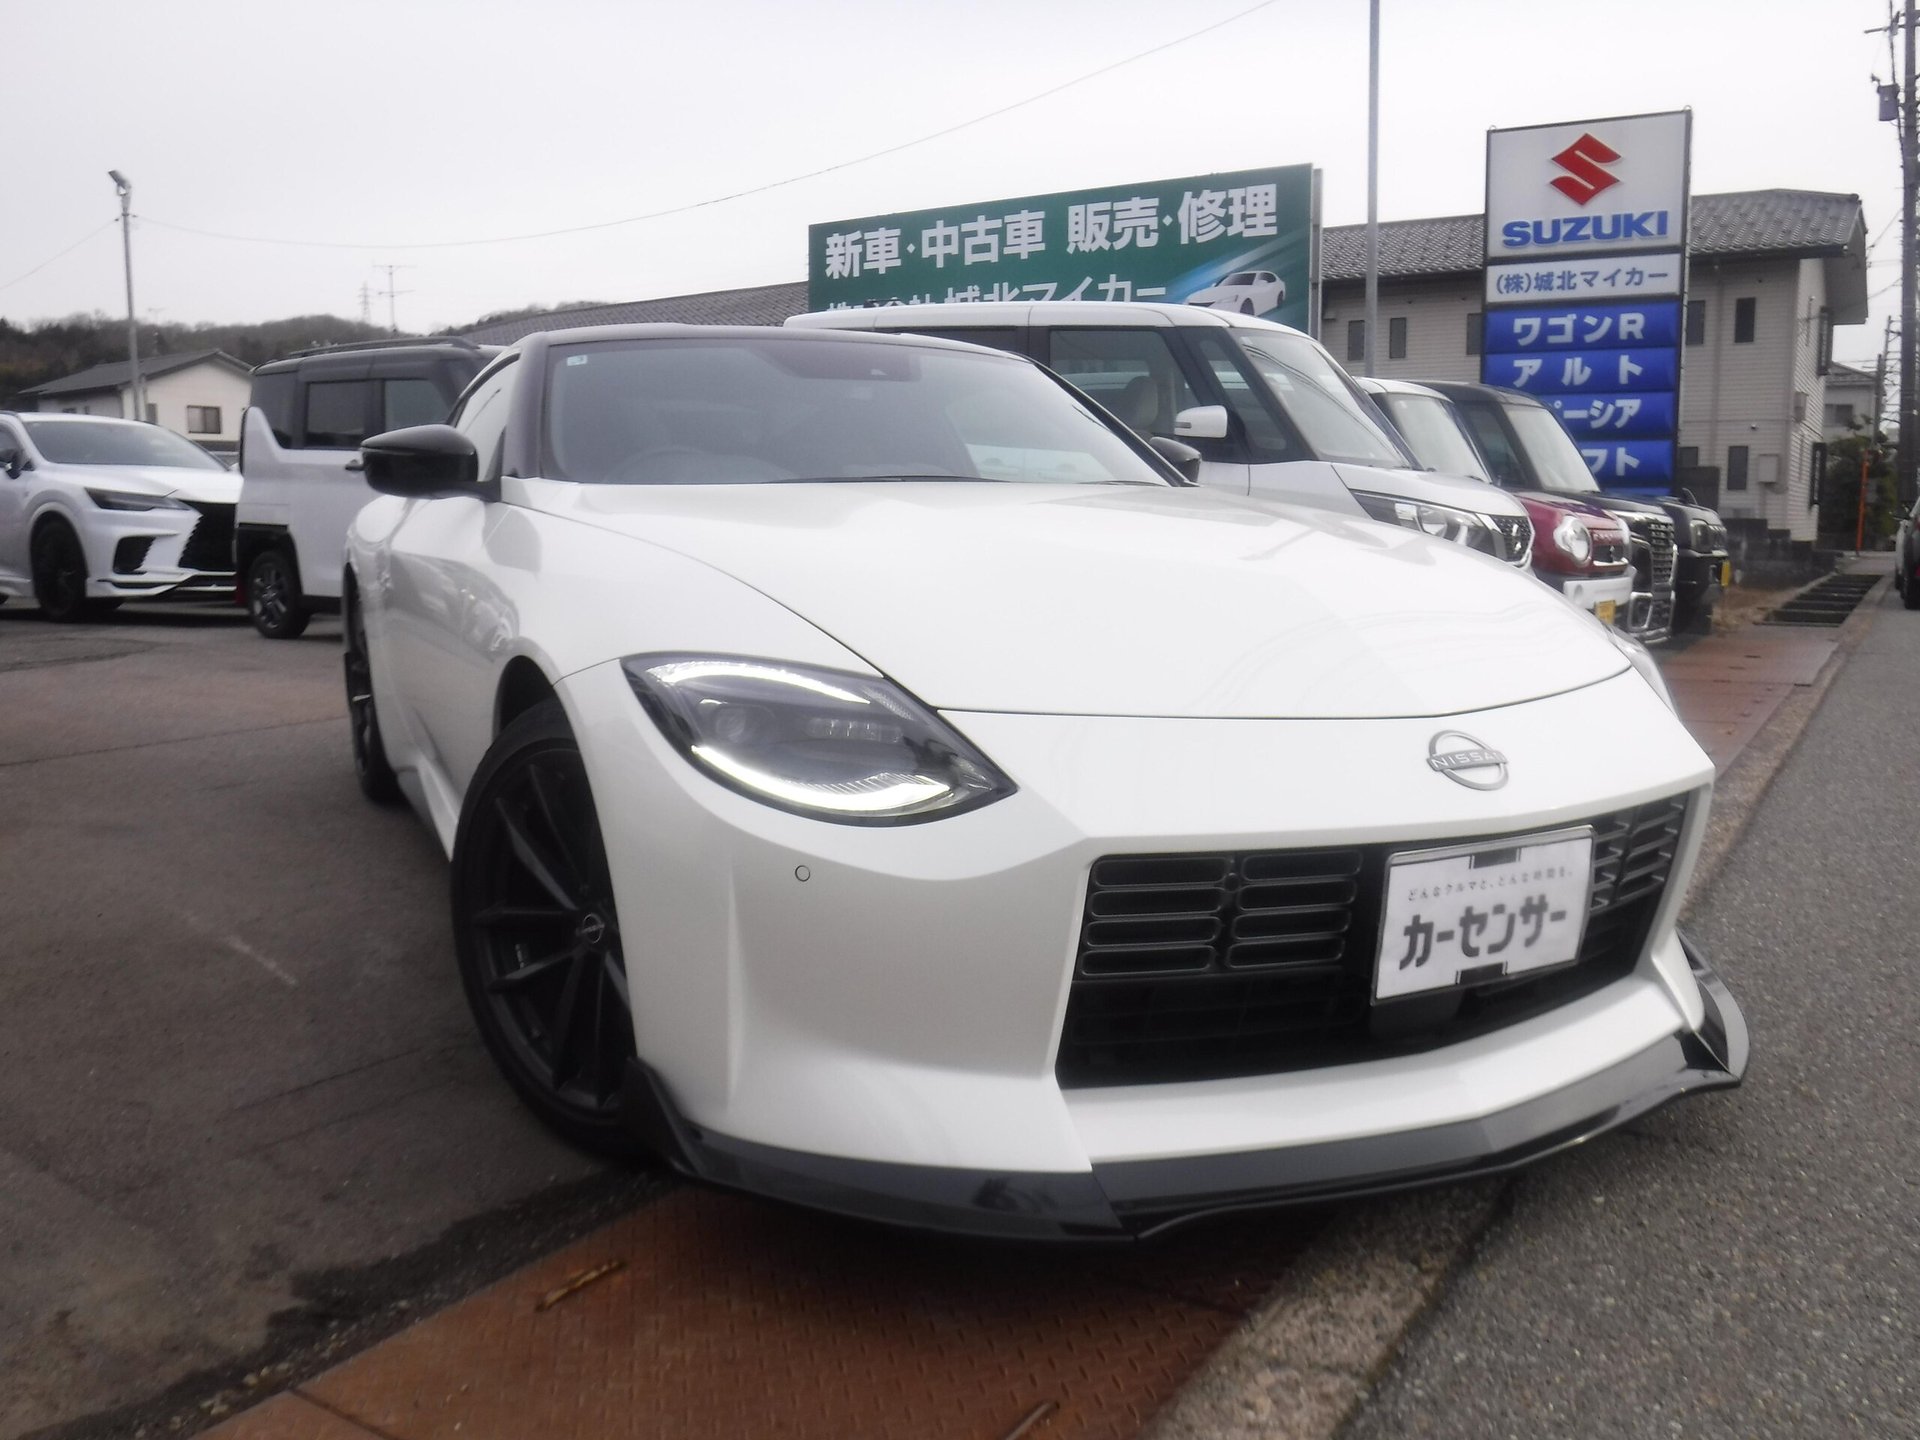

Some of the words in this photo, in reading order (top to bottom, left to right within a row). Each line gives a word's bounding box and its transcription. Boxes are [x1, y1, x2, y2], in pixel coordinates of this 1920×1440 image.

[825, 209, 1046, 280] 新車・中古車
[1066, 183, 1278, 255] 販売・修理
[1502, 210, 1668, 247] SUZUKI
[1513, 312, 1645, 346] ワゴンR
[1512, 354, 1643, 388] アルト
[1430, 751, 1506, 769] NISSAN
[1399, 893, 1567, 970] カーセンサー
